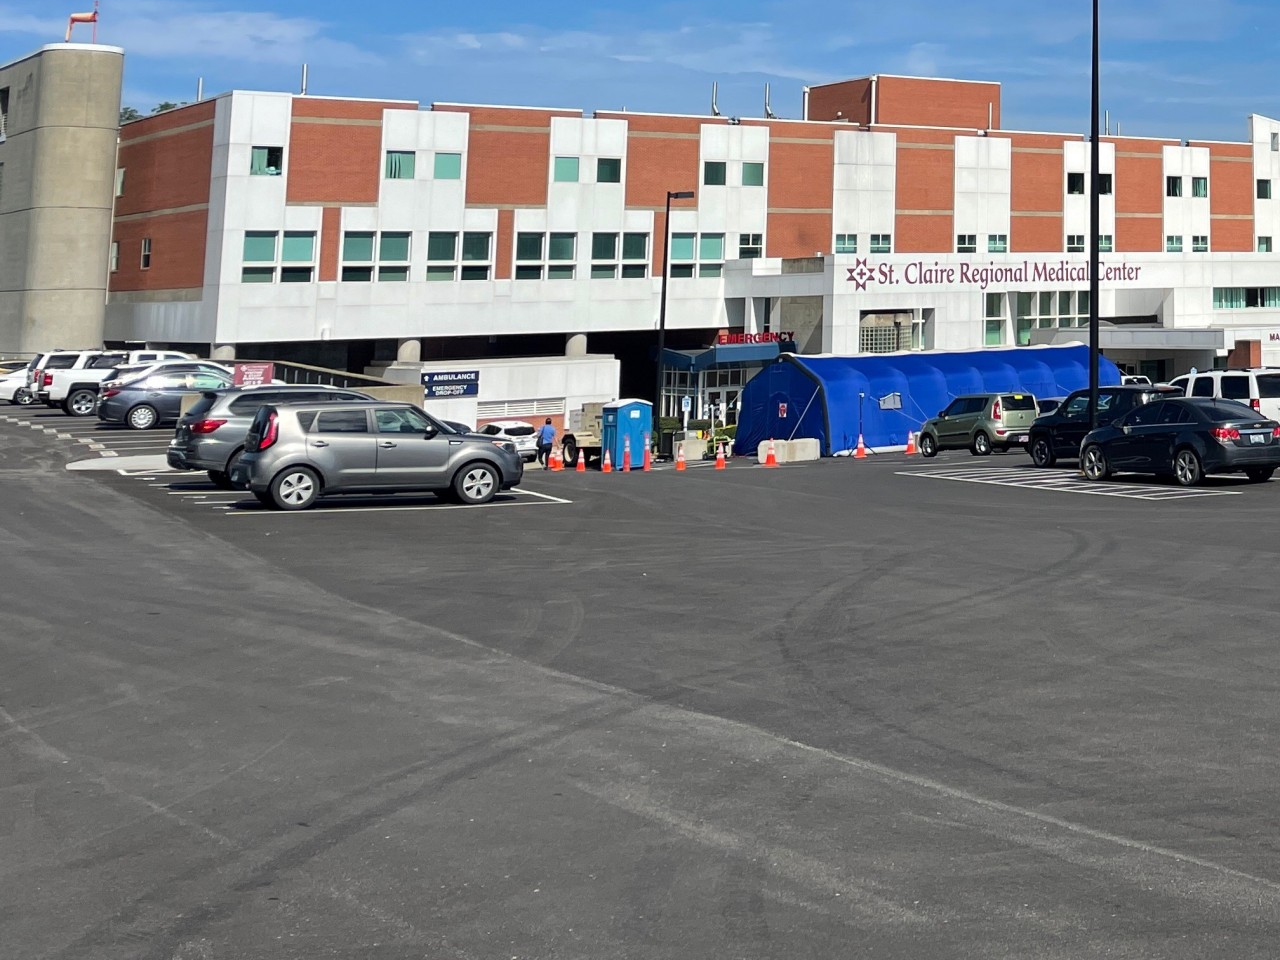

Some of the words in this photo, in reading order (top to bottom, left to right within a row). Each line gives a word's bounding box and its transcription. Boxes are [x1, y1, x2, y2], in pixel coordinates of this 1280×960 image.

[878, 262, 899, 285] St.
[904, 261, 955, 285] Claire
[959, 260, 1028, 290] Regional
[1032, 260, 1090, 282] Medical
[719, 331, 795, 345] EMERGENCY
[433, 373, 476, 381] AMBULANCE
